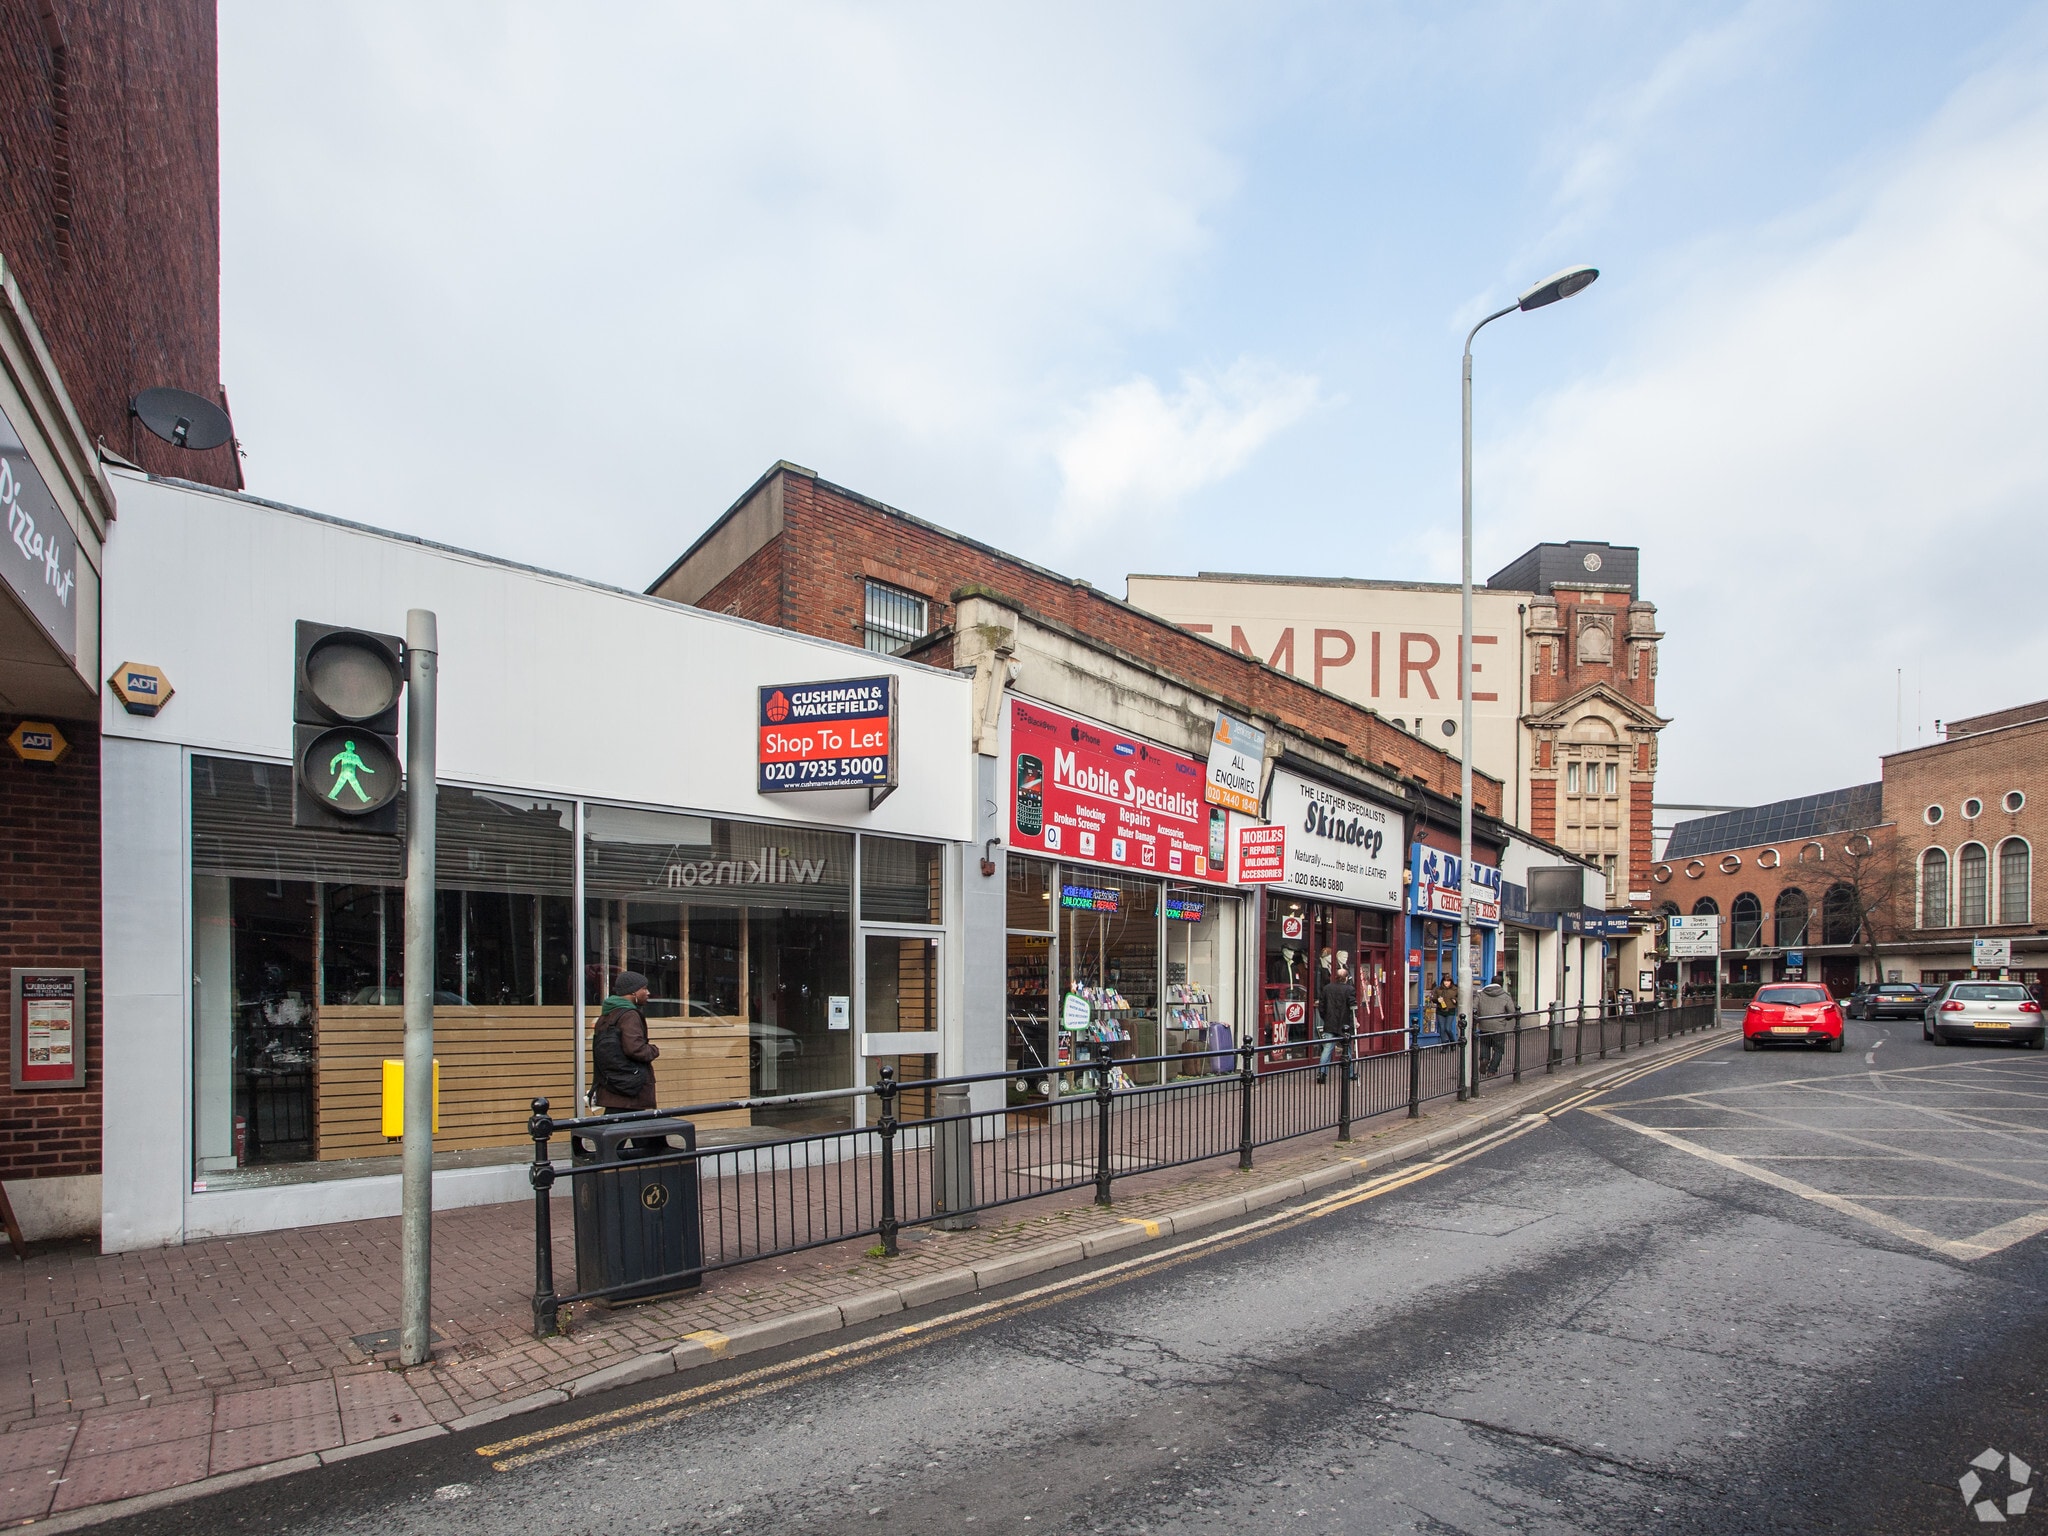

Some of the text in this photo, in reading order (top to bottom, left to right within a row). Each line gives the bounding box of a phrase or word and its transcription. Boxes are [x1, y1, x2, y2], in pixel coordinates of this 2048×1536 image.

[0, 458, 74, 608] Pizza Hut
[1173, 623, 1498, 701] MPIRE
[129, 676, 157, 692] ADT
[792, 687, 882, 704] CUSHMAN &
[23, 734, 52, 748] ADT
[766, 728, 883, 757] Shop To Let
[1080, 730, 1101, 746] iPhone
[765, 757, 883, 780] 020 7935 5000
[1176, 762, 1197, 777] NOKIA
[1231, 755, 1245, 771] ALL
[784, 778, 863, 788] www.cushmanwakefield.com
[1054, 747, 1199, 818] Mobile Specialist
[1215, 769, 1255, 794] ENQUIRIES
[1207, 785, 1257, 812] 020 7440 1840
[1300, 784, 1386, 824] THE LEATHER SPECIALISTS
[1054, 812, 1100, 832] Broken Screens
[1076, 804, 1106, 823] Unlocking
[1119, 807, 1151, 827] Repairs
[1117, 826, 1156, 844] Water Damage
[1157, 824, 1184, 839] Accessories
[1242, 829, 1283, 844] MOBILES
[1304, 800, 1383, 859] Skindeep
[1170, 837, 1203, 855] Data Recovery
[1250, 845, 1275, 855] REPAIRS
[1245, 857, 1280, 867] UNLOCKING
[1336, 861, 1346, 871] the
[1346, 862, 1359, 874] best
[1360, 864, 1364, 873] in
[1365, 866, 1387, 880] LEATHER
[1242, 869, 1283, 879] ACCESSORIES
[1295, 872, 1308, 885] 020
[1310, 875, 1326, 889] 8546
[1328, 879, 1344, 891] 5880
[1063, 896, 1092, 908] UNLOCKING
[1097, 901, 1117, 911] REPAIRS
[1388, 891, 1397, 901] 145
[1482, 903, 1497, 918] RIBS
